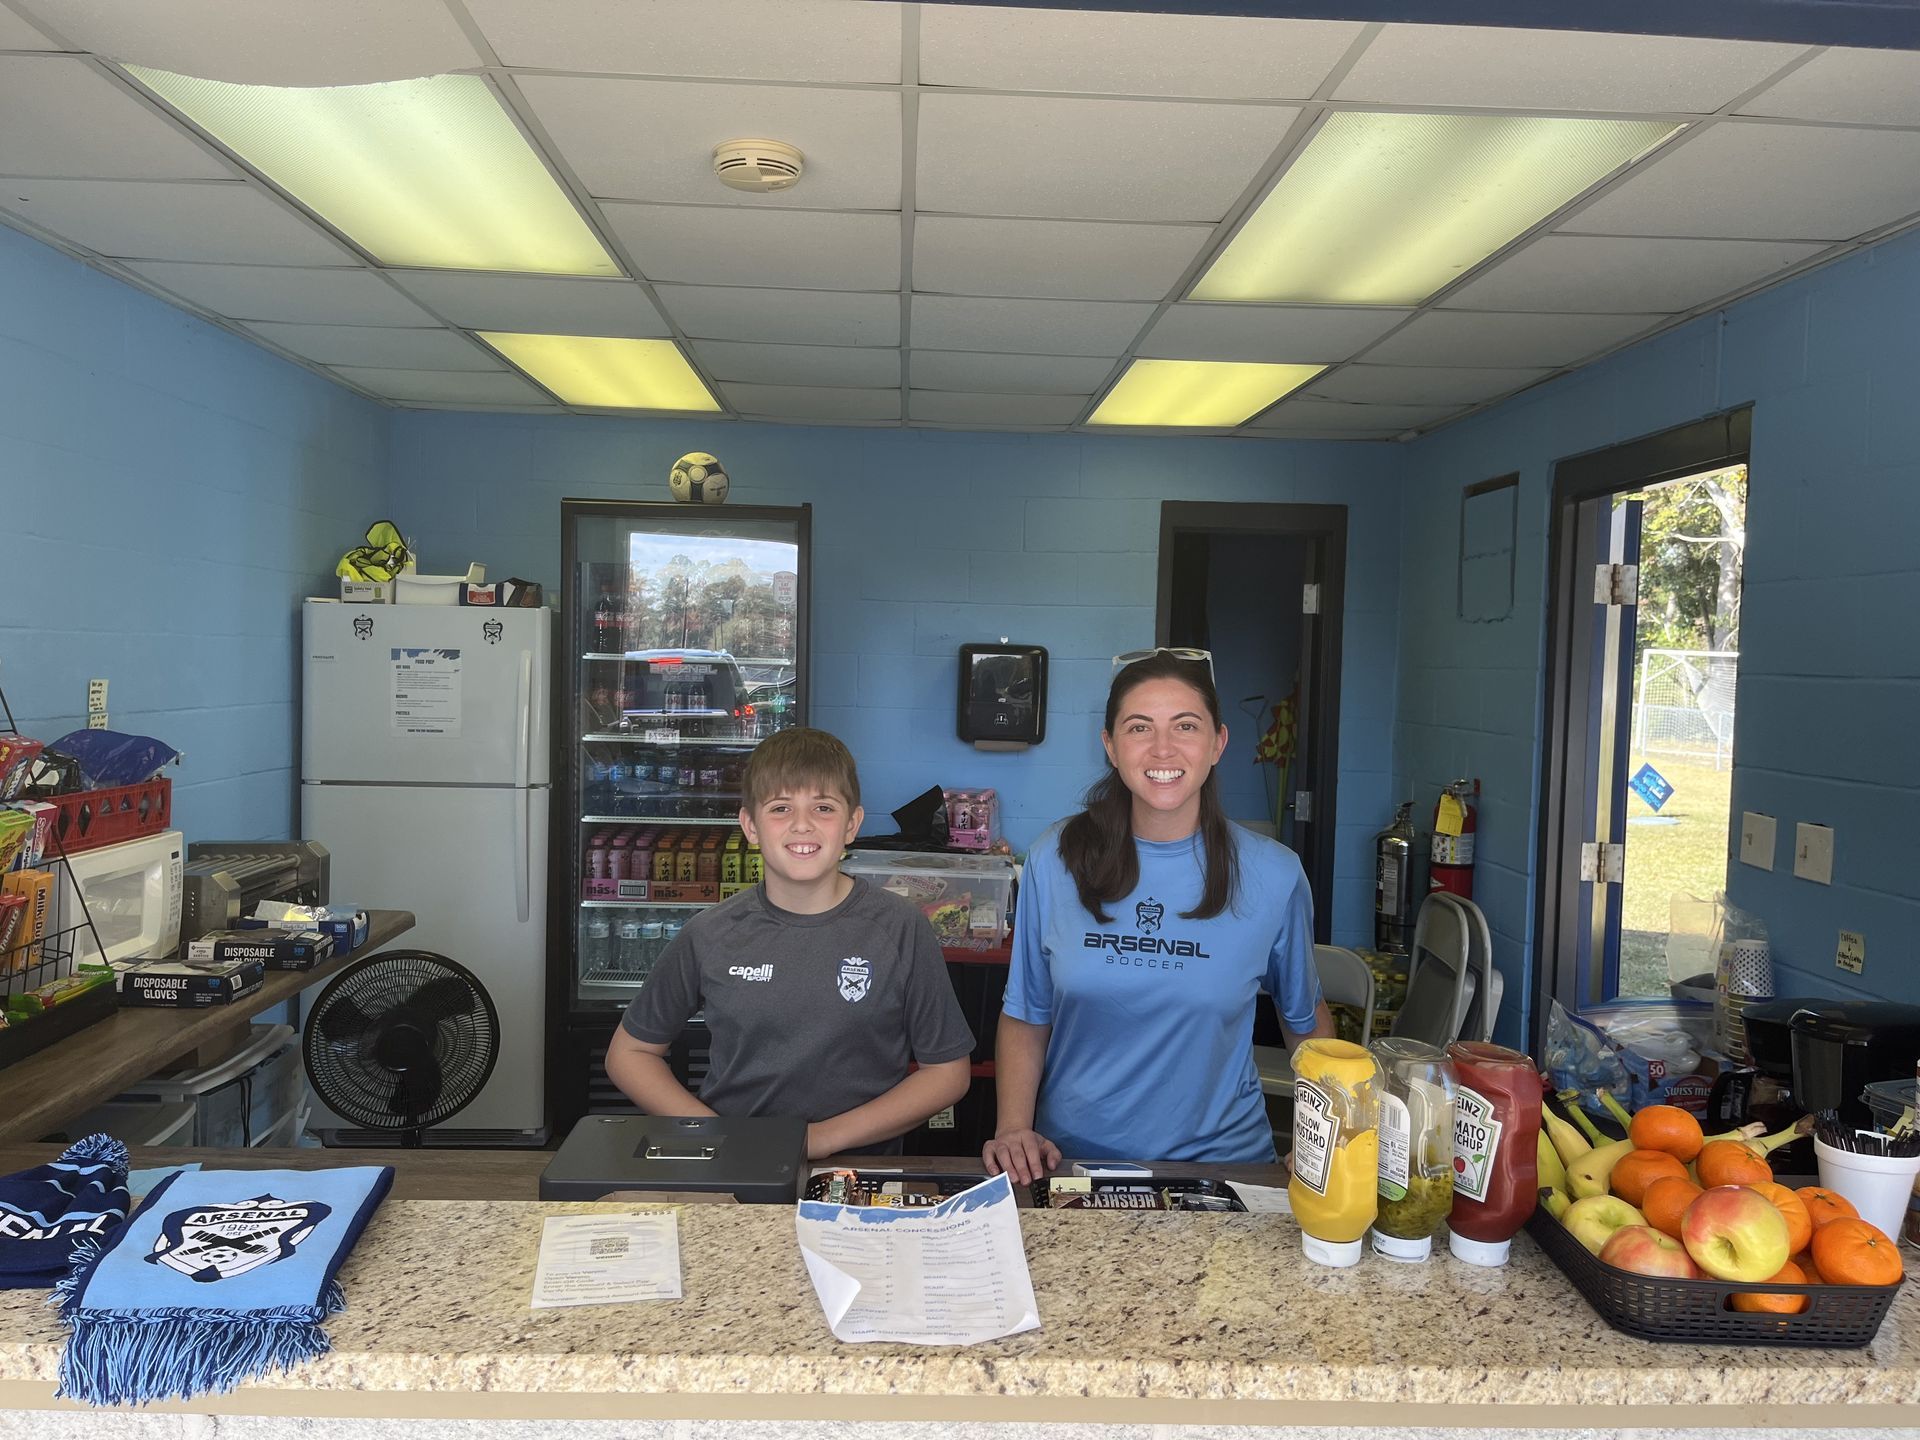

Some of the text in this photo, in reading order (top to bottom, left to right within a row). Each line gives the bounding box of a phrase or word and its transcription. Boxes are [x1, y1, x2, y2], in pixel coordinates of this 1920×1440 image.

[224, 947, 276, 958] DISPOSABLE
[728, 963, 774, 979] capelli
[1106, 955, 1184, 971] SOCCER
[134, 977, 188, 989] DISPOSABLE
[143, 989, 178, 1000] GLOVES
[1650, 1064, 1664, 1075] 50
[1299, 1089, 1322, 1113] HEINZ
[1457, 1096, 1481, 1118] EINZ
[1298, 1111, 1321, 1132] YELLOW
[1296, 1121, 1326, 1149] MUSTARD
[1456, 1119, 1486, 1142] MATO
[1454, 1132, 1483, 1152] TCHUP
[1082, 1193, 1157, 1209] HERSHEY'S
[193, 1210, 305, 1225] ARSENAL
[219, 1223, 260, 1232] 1982
[895, 1219, 971, 1233] CONCESSIONS
